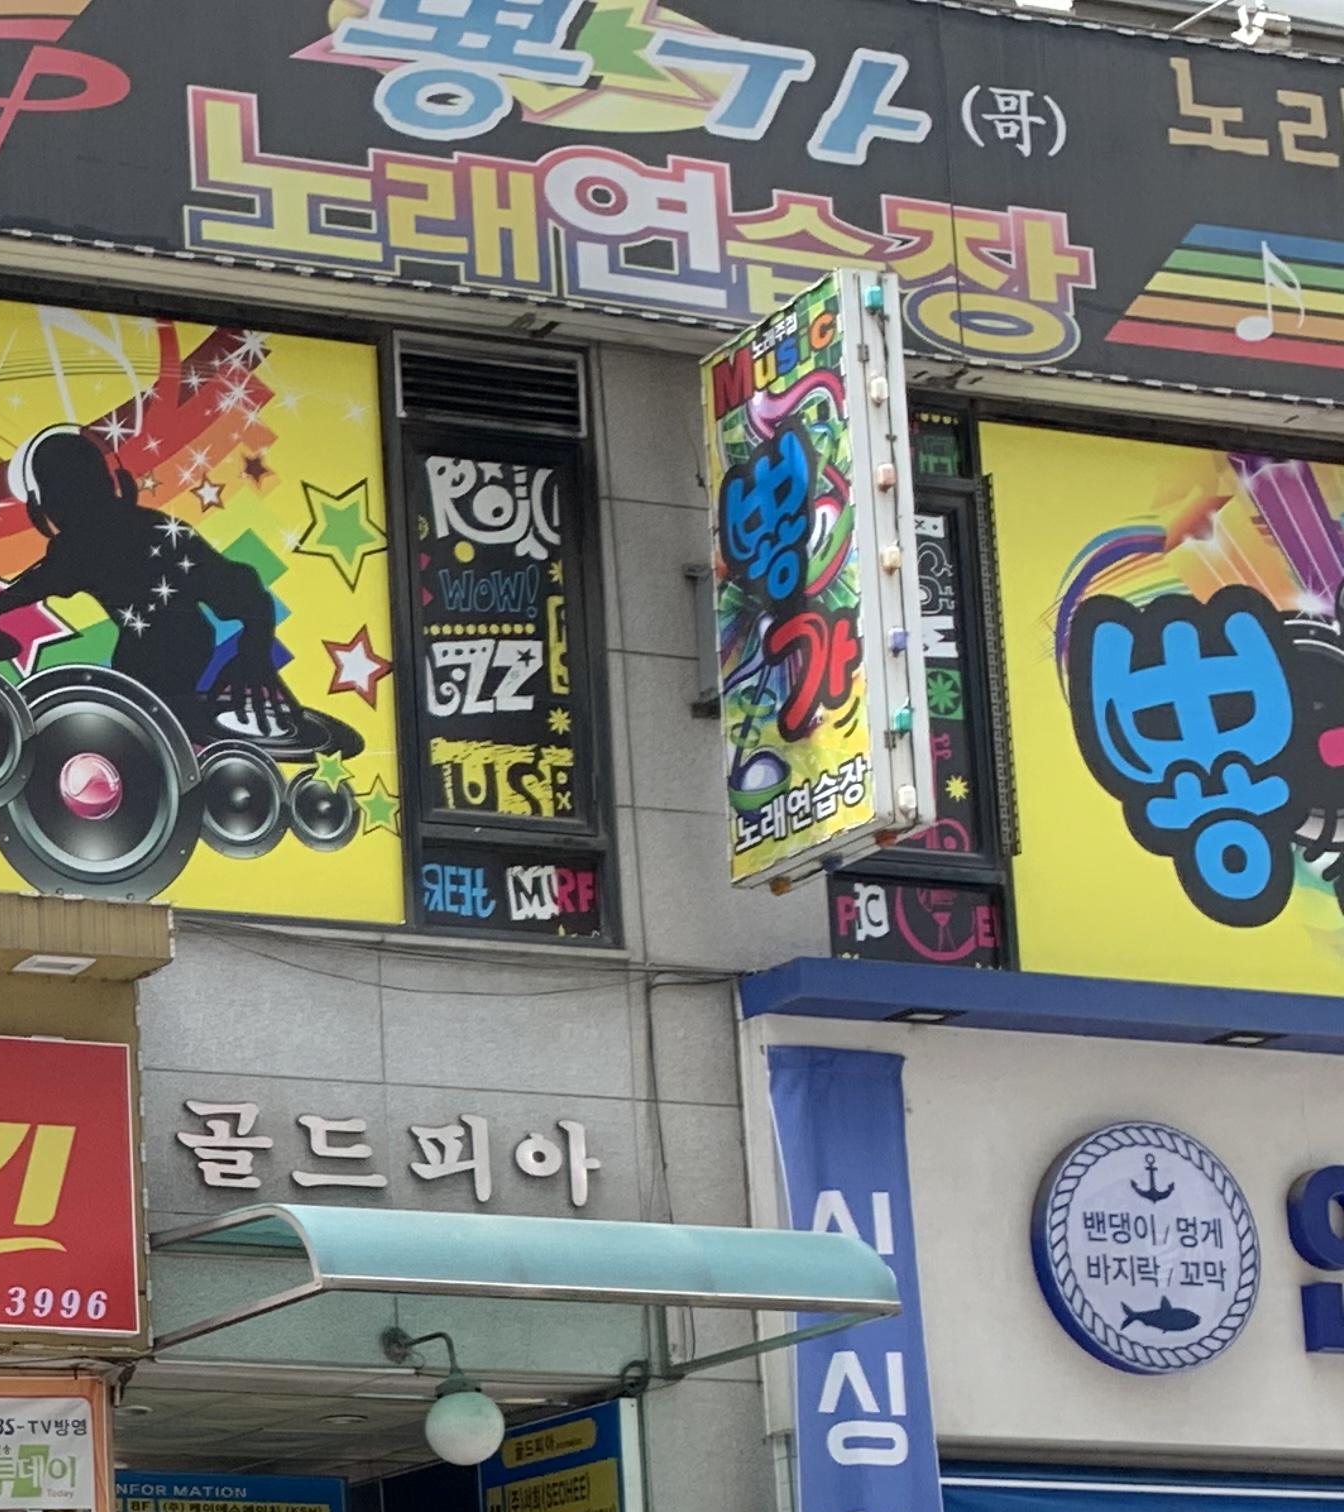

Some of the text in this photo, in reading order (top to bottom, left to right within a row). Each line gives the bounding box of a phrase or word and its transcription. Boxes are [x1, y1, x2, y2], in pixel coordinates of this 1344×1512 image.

[713, 309, 838, 419] Music
[733, 755, 870, 853] 노래연습장
[1082, 600, 1344, 910] 뿅
[177, 1098, 601, 1207] 골드피아
[1083, 1211, 1226, 1250] 밴댕이 멍게
[1086, 1255, 1228, 1292] 바지락 꼬막
[116, 1483, 248, 1498] NFOR MATION
